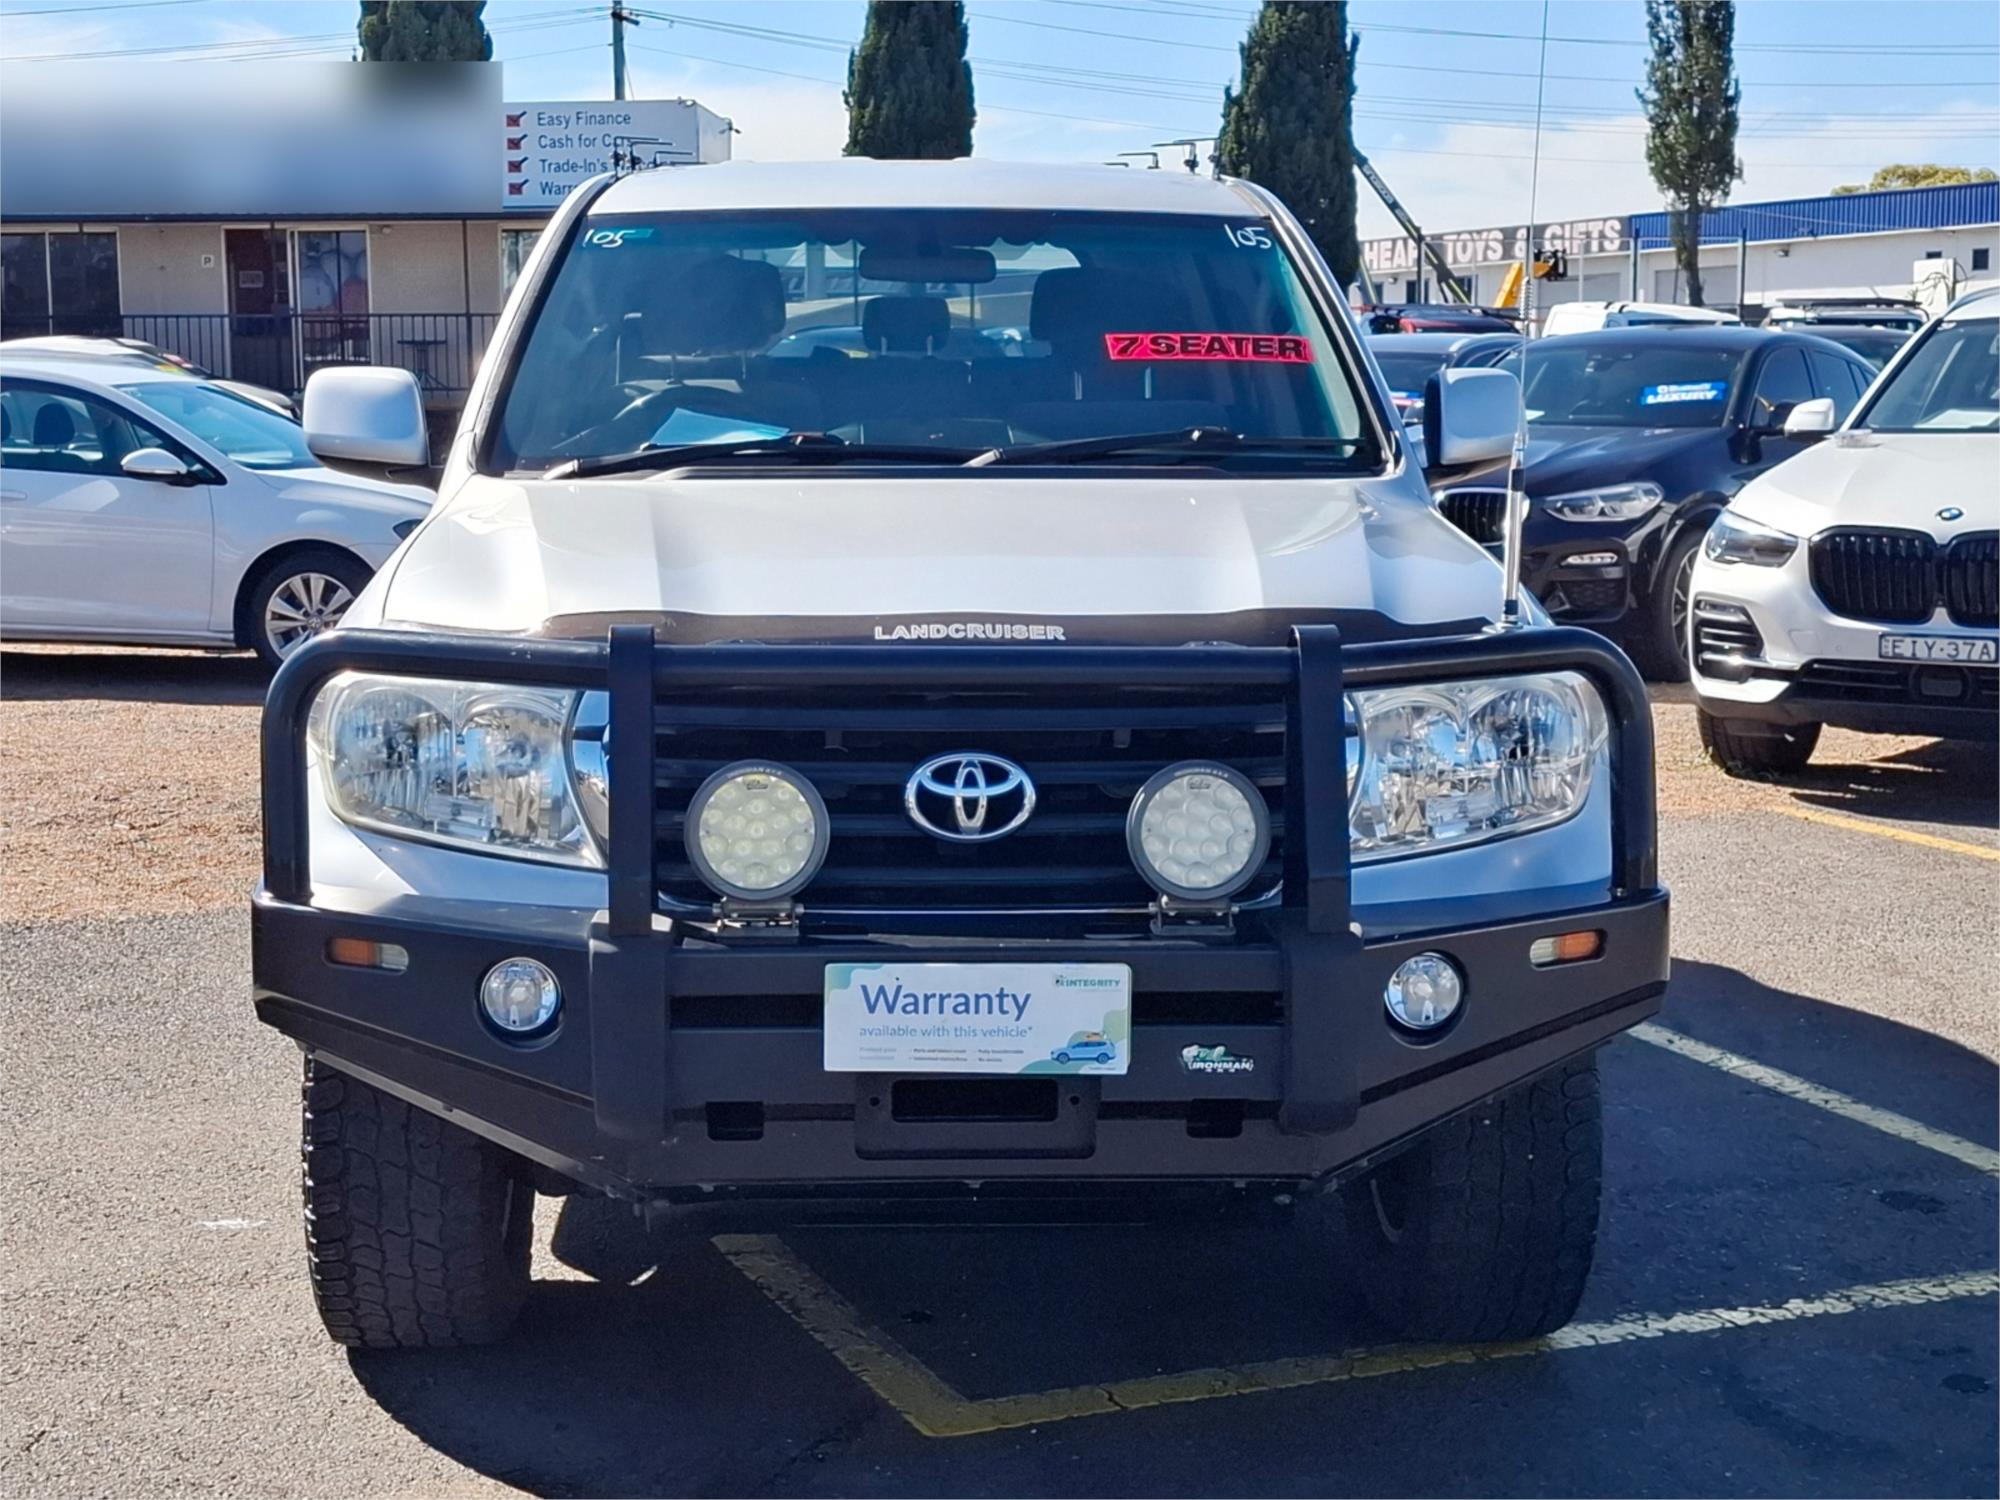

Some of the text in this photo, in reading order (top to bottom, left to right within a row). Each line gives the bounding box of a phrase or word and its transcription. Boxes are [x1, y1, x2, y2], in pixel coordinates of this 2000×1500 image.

[537, 110, 631, 128] Easy Finance
[538, 133, 573, 149] Cash
[578, 132, 598, 148] for
[539, 157, 608, 173] Trade-In's
[539, 180, 577, 196] Warr
[581, 228, 637, 249] 105
[1223, 223, 1272, 249] 105
[1442, 230, 1504, 263] TOYS
[1543, 218, 1622, 255] GIFTS
[1113, 335, 1306, 358] 7 SEATER
[874, 623, 1067, 641] LANDCRUISER
[860, 983, 1032, 1022] Warranty
[859, 1024, 918, 1038] available
[920, 1025, 950, 1038] with
[953, 1025, 979, 1038] this
